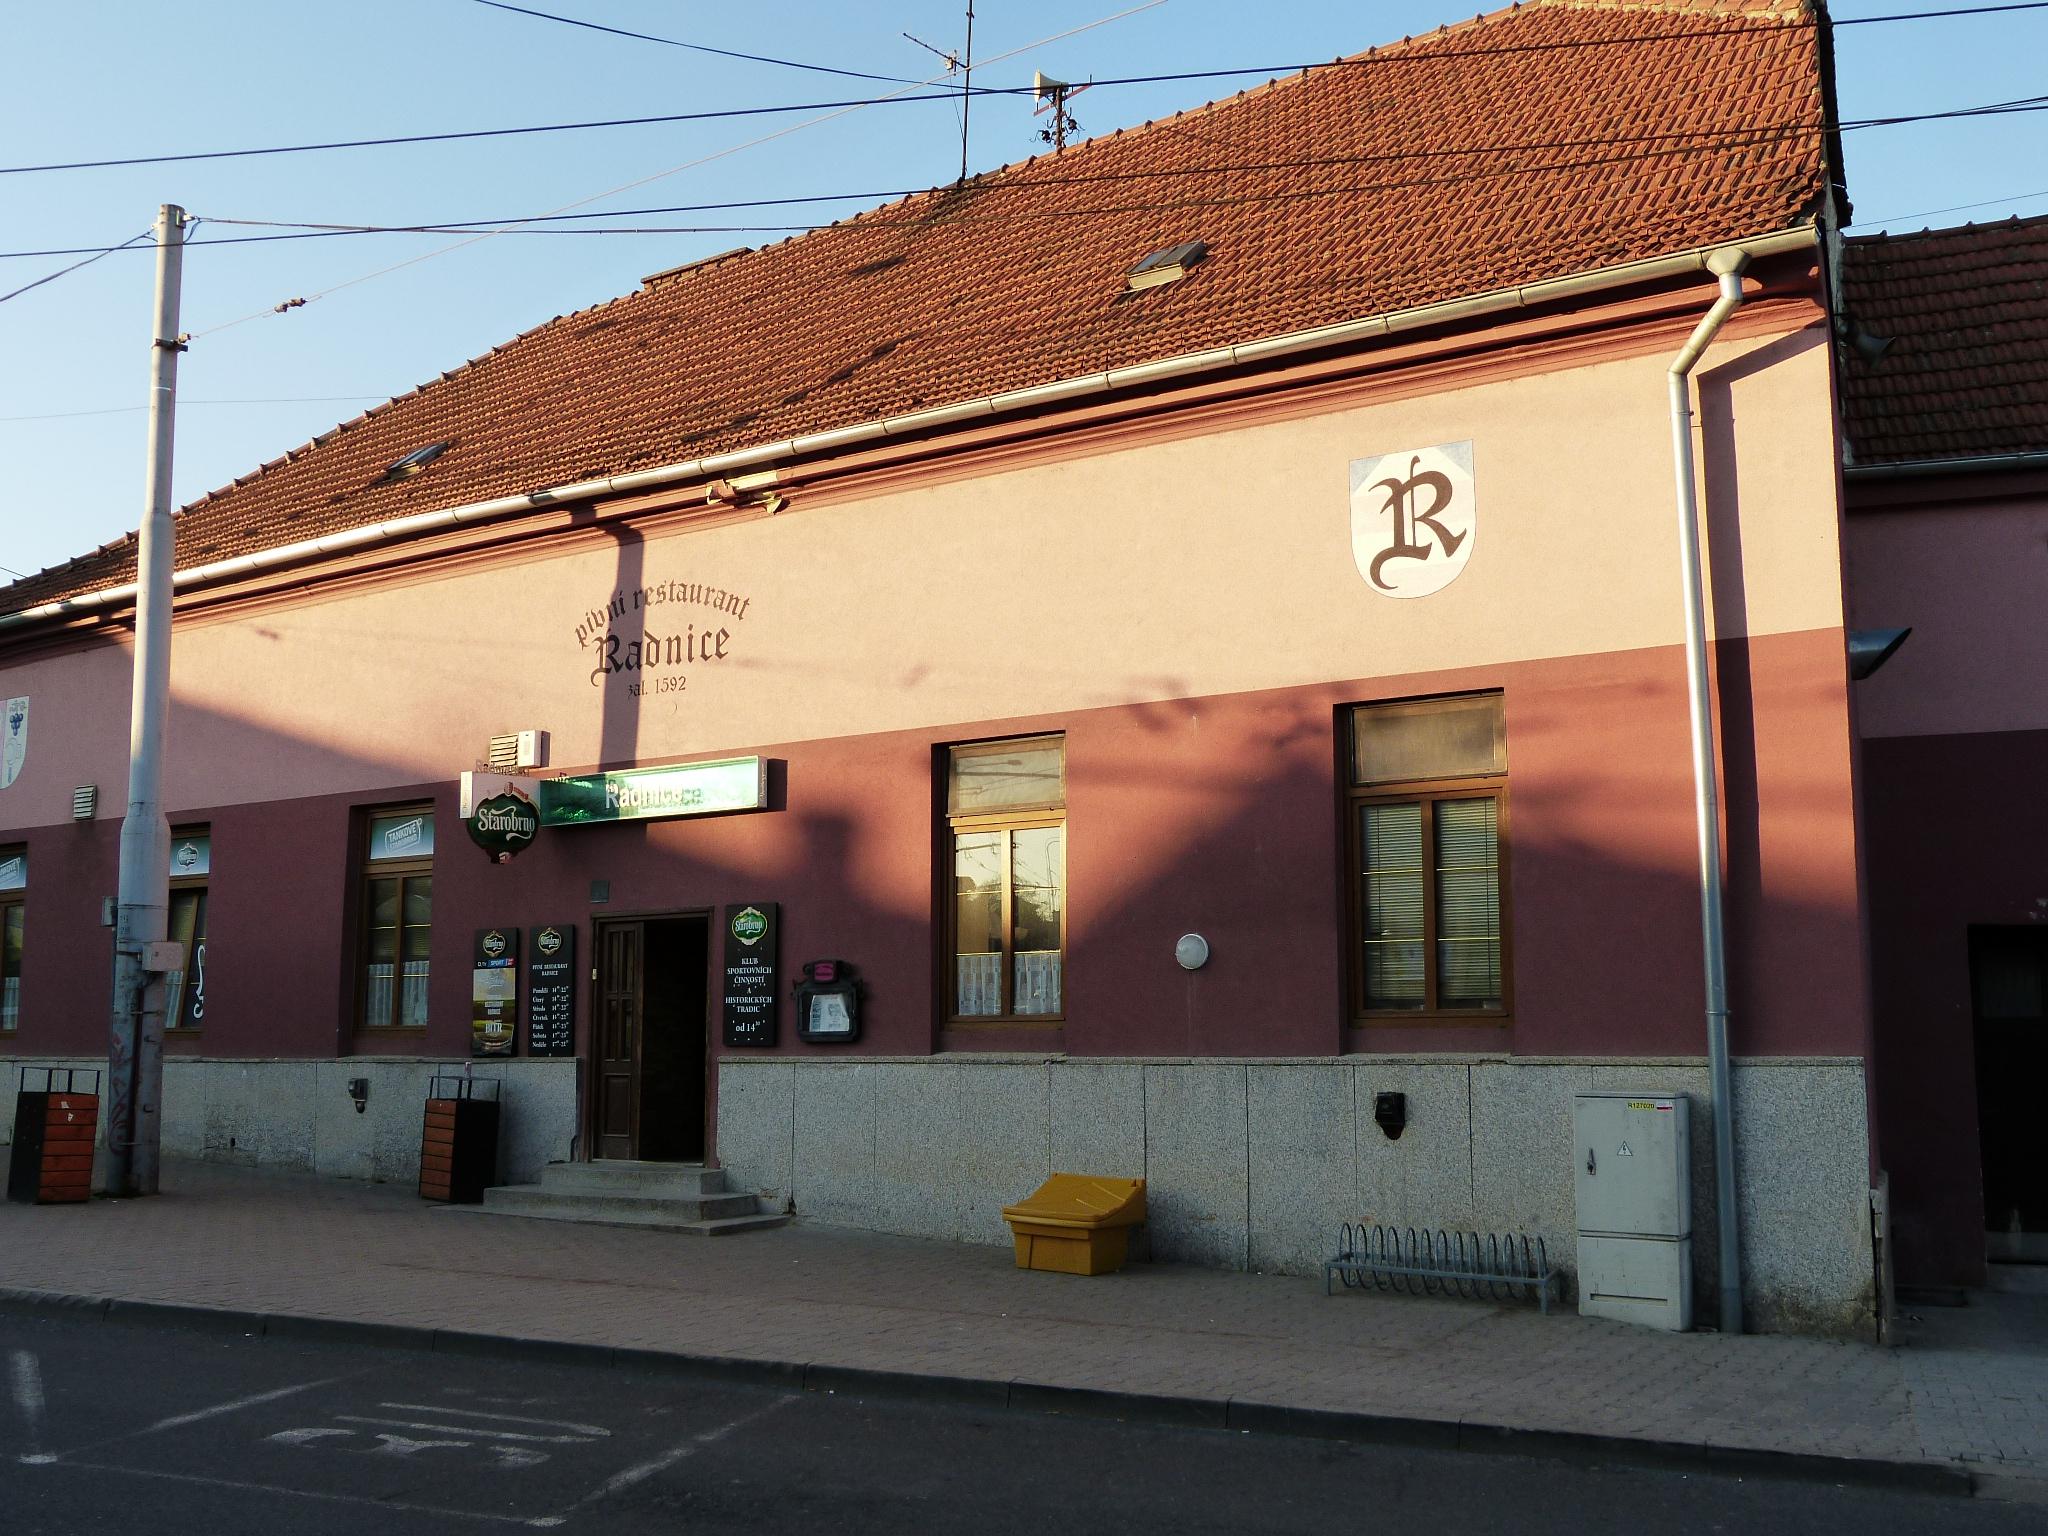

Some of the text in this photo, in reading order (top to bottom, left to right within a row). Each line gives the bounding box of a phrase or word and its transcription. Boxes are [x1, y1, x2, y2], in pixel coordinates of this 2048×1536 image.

[1367, 454, 1467, 591] R
[633, 578, 750, 621] restaurant
[590, 622, 730, 687] Radnice
[655, 675, 687, 694] 1592
[477, 805, 536, 841] Starobrno
[727, 966, 772, 975] SPORTOVNÍCH
[741, 957, 759, 965] KLUB
[725, 996, 772, 1004] HISTORICKÝCH
[735, 1022, 745, 1032] od
